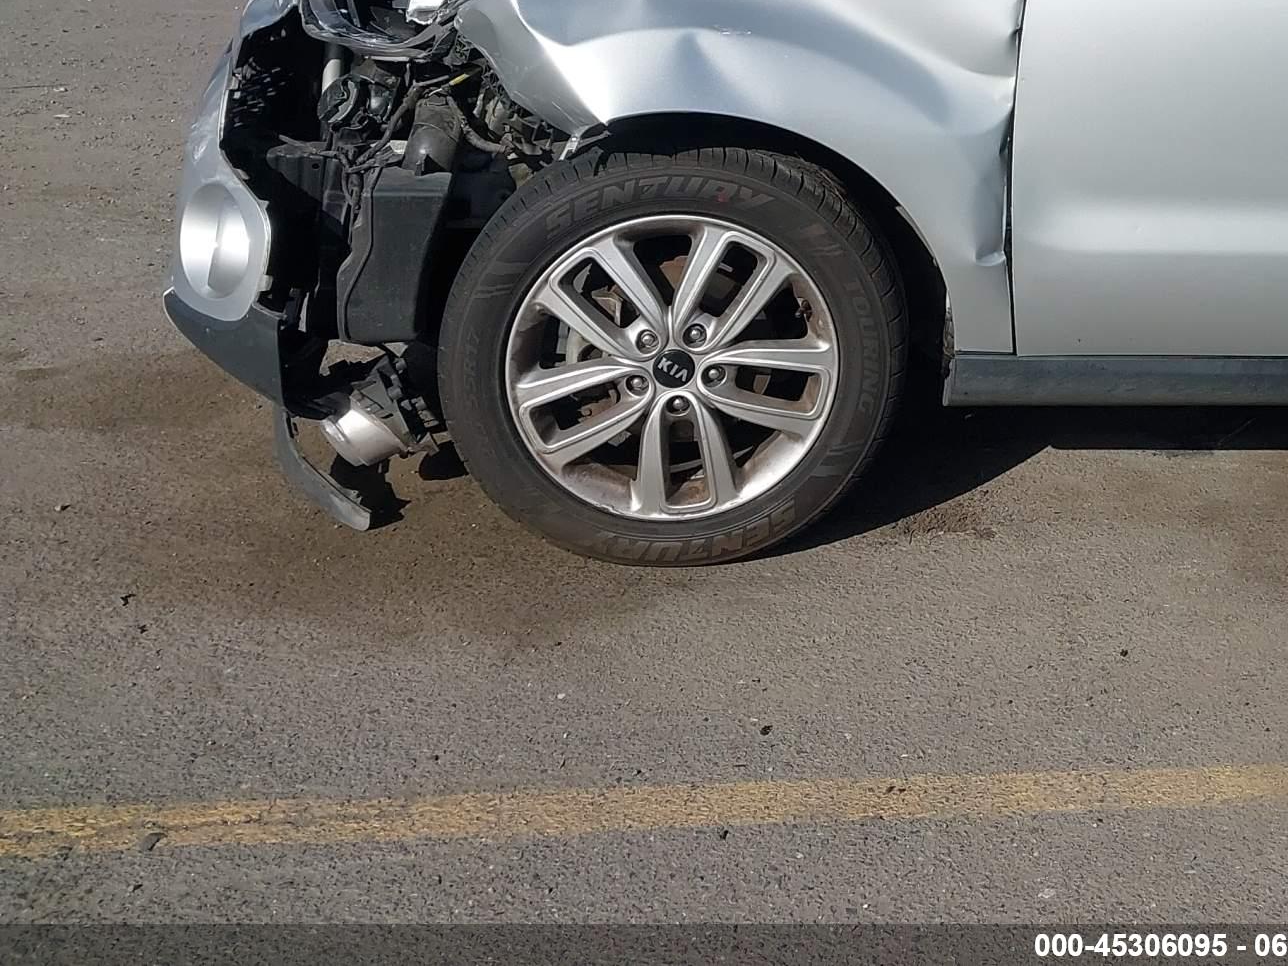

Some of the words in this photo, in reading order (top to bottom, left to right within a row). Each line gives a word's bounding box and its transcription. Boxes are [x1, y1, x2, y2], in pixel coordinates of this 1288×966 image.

[545, 176, 776, 238] SENTURY
[657, 356, 688, 382] KIA
[847, 280, 881, 414] TOURING
